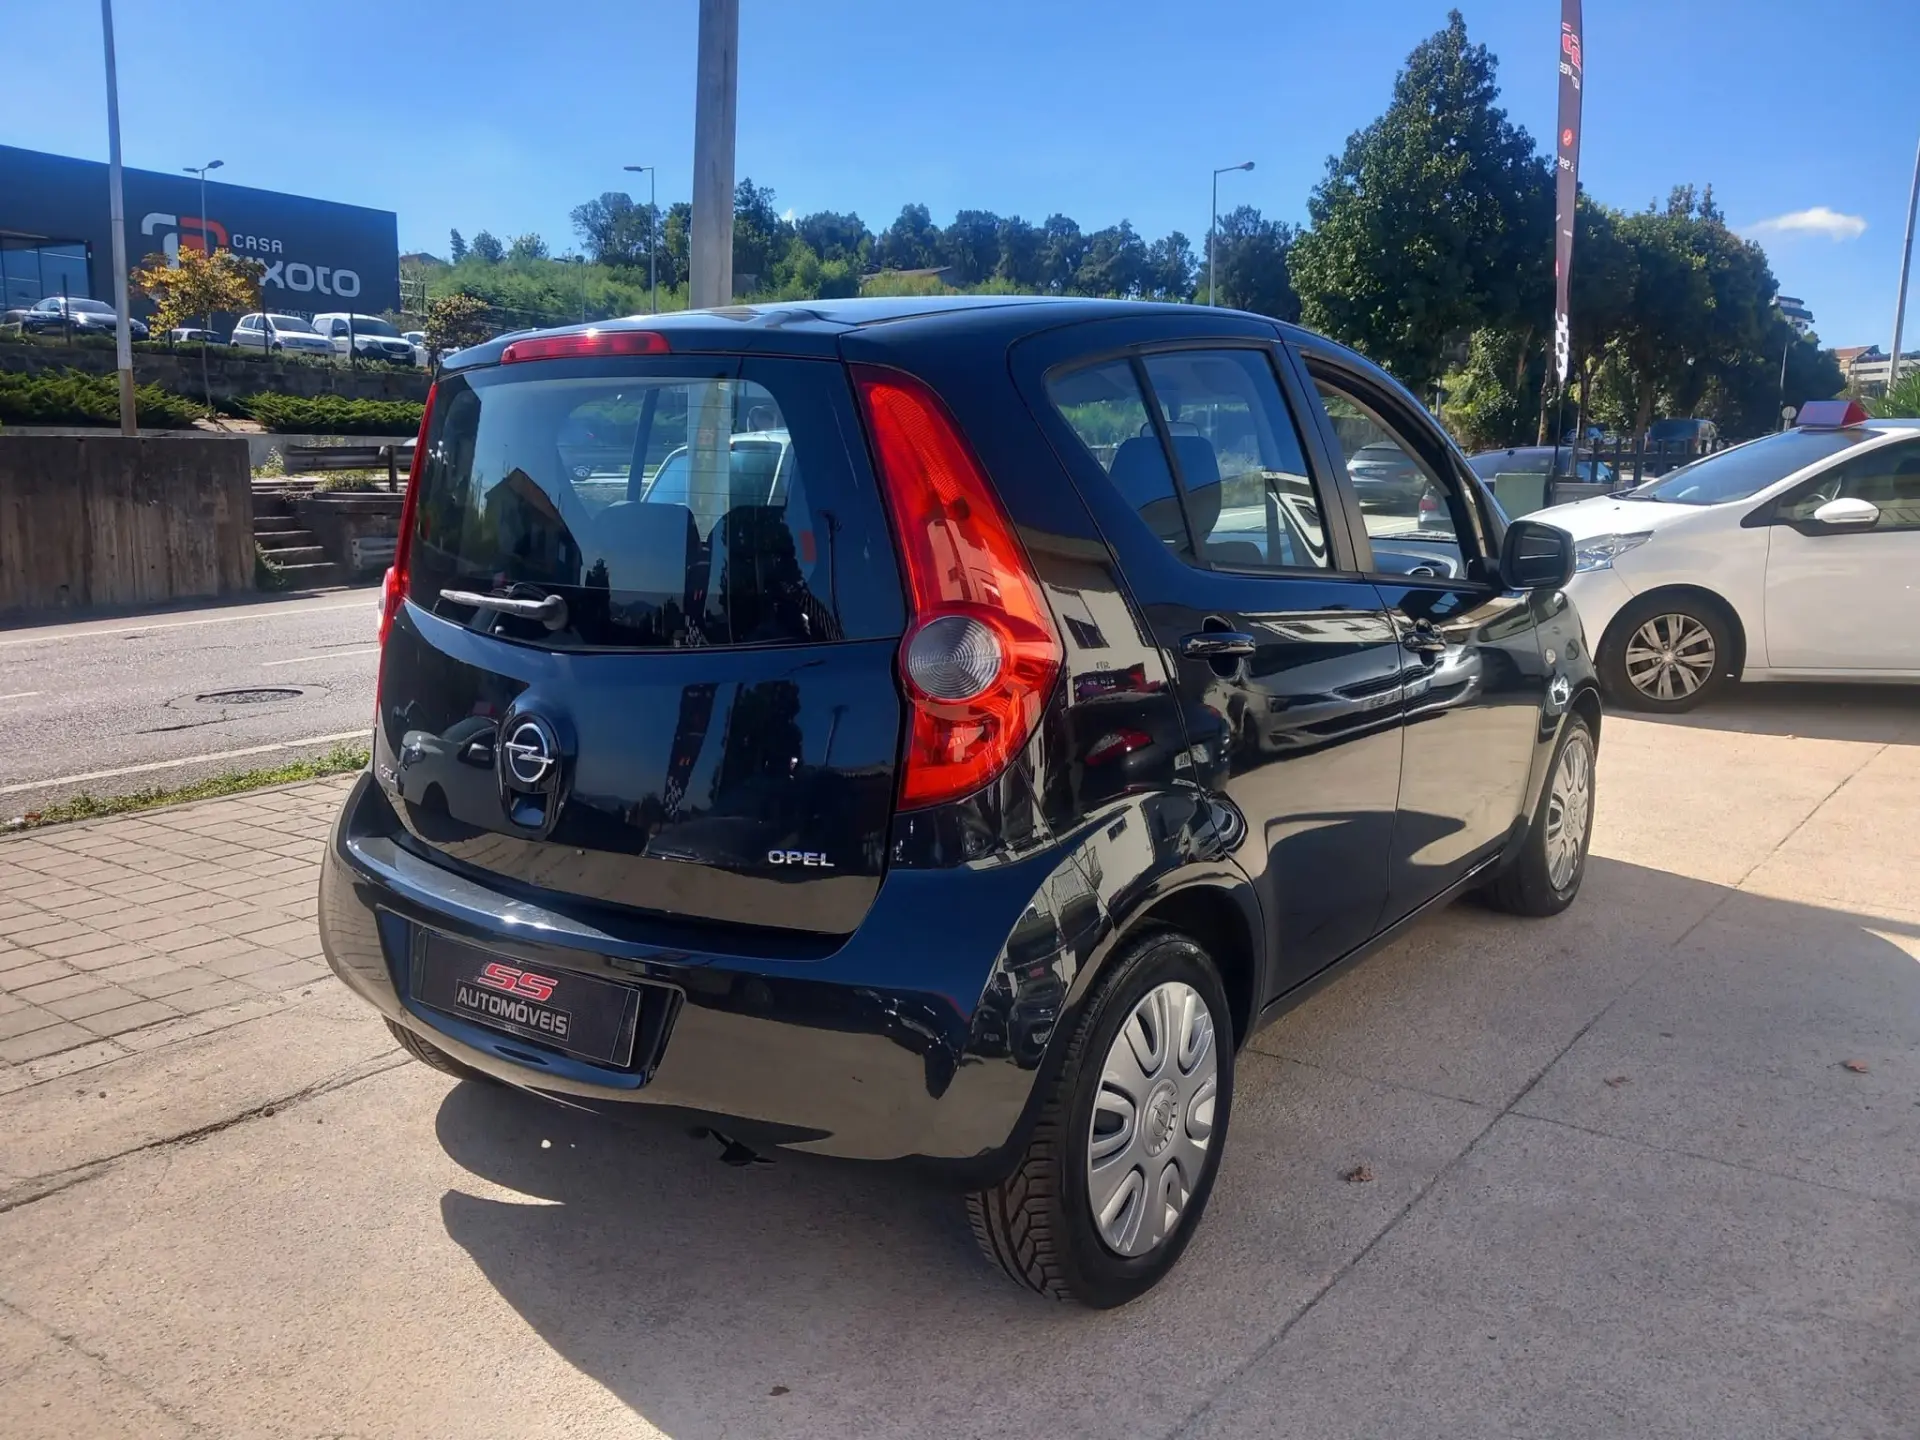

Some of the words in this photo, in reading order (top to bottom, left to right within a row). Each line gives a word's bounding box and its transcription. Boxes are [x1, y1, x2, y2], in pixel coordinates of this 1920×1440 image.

[232, 234, 283, 254] CASA
[768, 850, 835, 867] OPEL
[477, 962, 558, 1002] SS
[457, 986, 568, 1035] AUTOMÓVEIS
